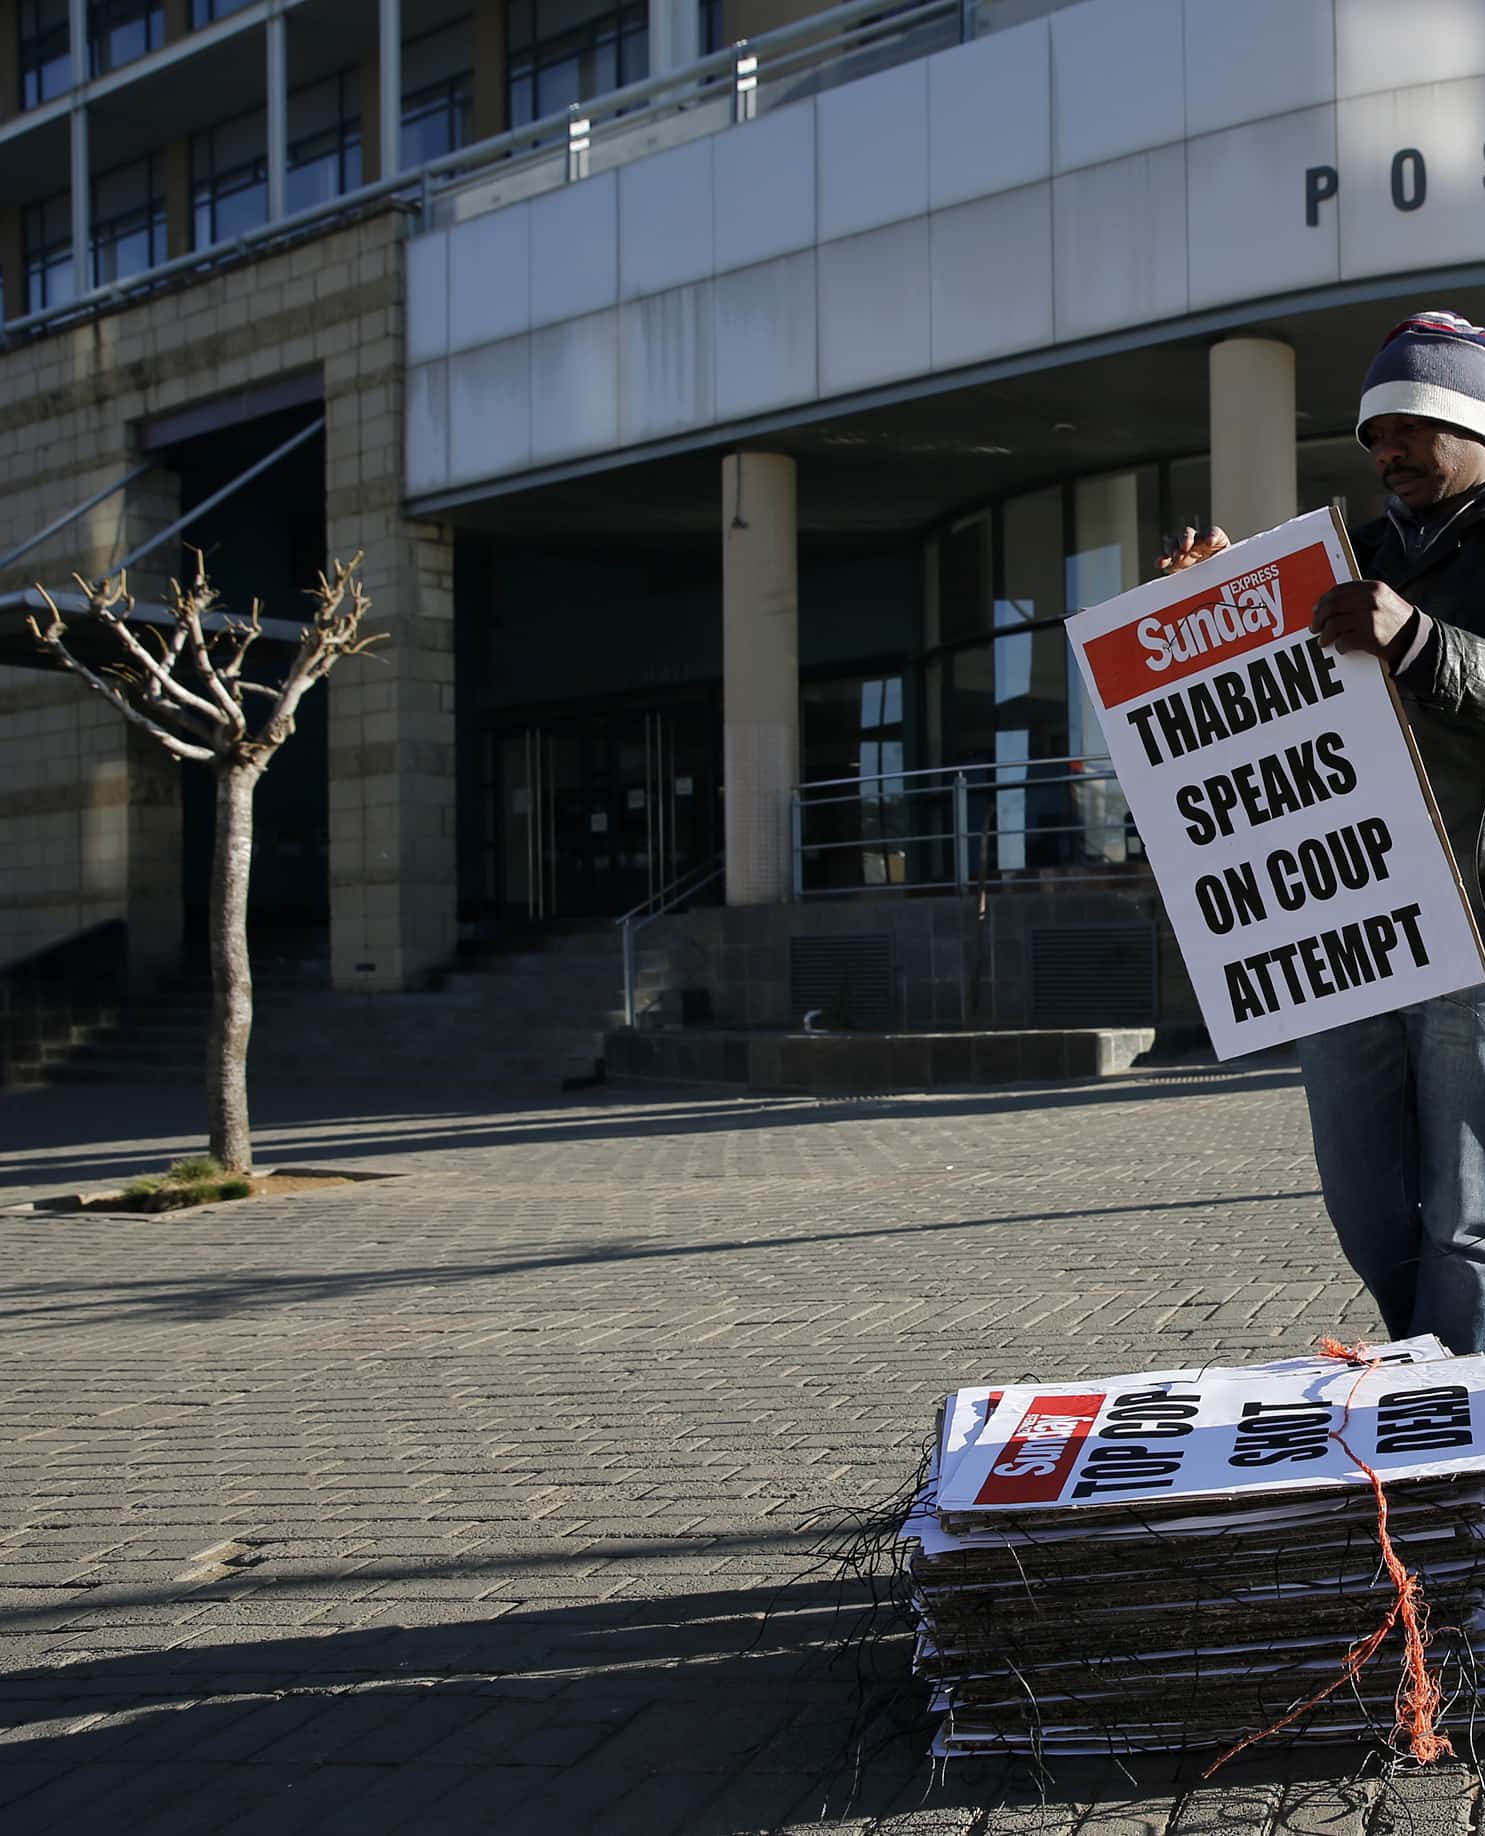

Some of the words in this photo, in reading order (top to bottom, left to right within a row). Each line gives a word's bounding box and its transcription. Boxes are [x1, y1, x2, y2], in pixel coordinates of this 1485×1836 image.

[1230, 564, 1280, 595] EXPRESS
[1137, 578, 1285, 672] Sunday
[1126, 636, 1345, 768] THABANE
[1176, 731, 1359, 846] SPEAKS
[1195, 861, 1263, 935] ON
[1267, 817, 1394, 911] COUP
[1223, 903, 1431, 1024] ATTEMPT
[993, 1414, 1094, 1477] Sunday
[1098, 1390, 1202, 1440] COP
[1228, 1400, 1333, 1467] SHOT
[1376, 1385, 1473, 1453] DEAD
[1071, 1445, 1185, 1499] TOP
